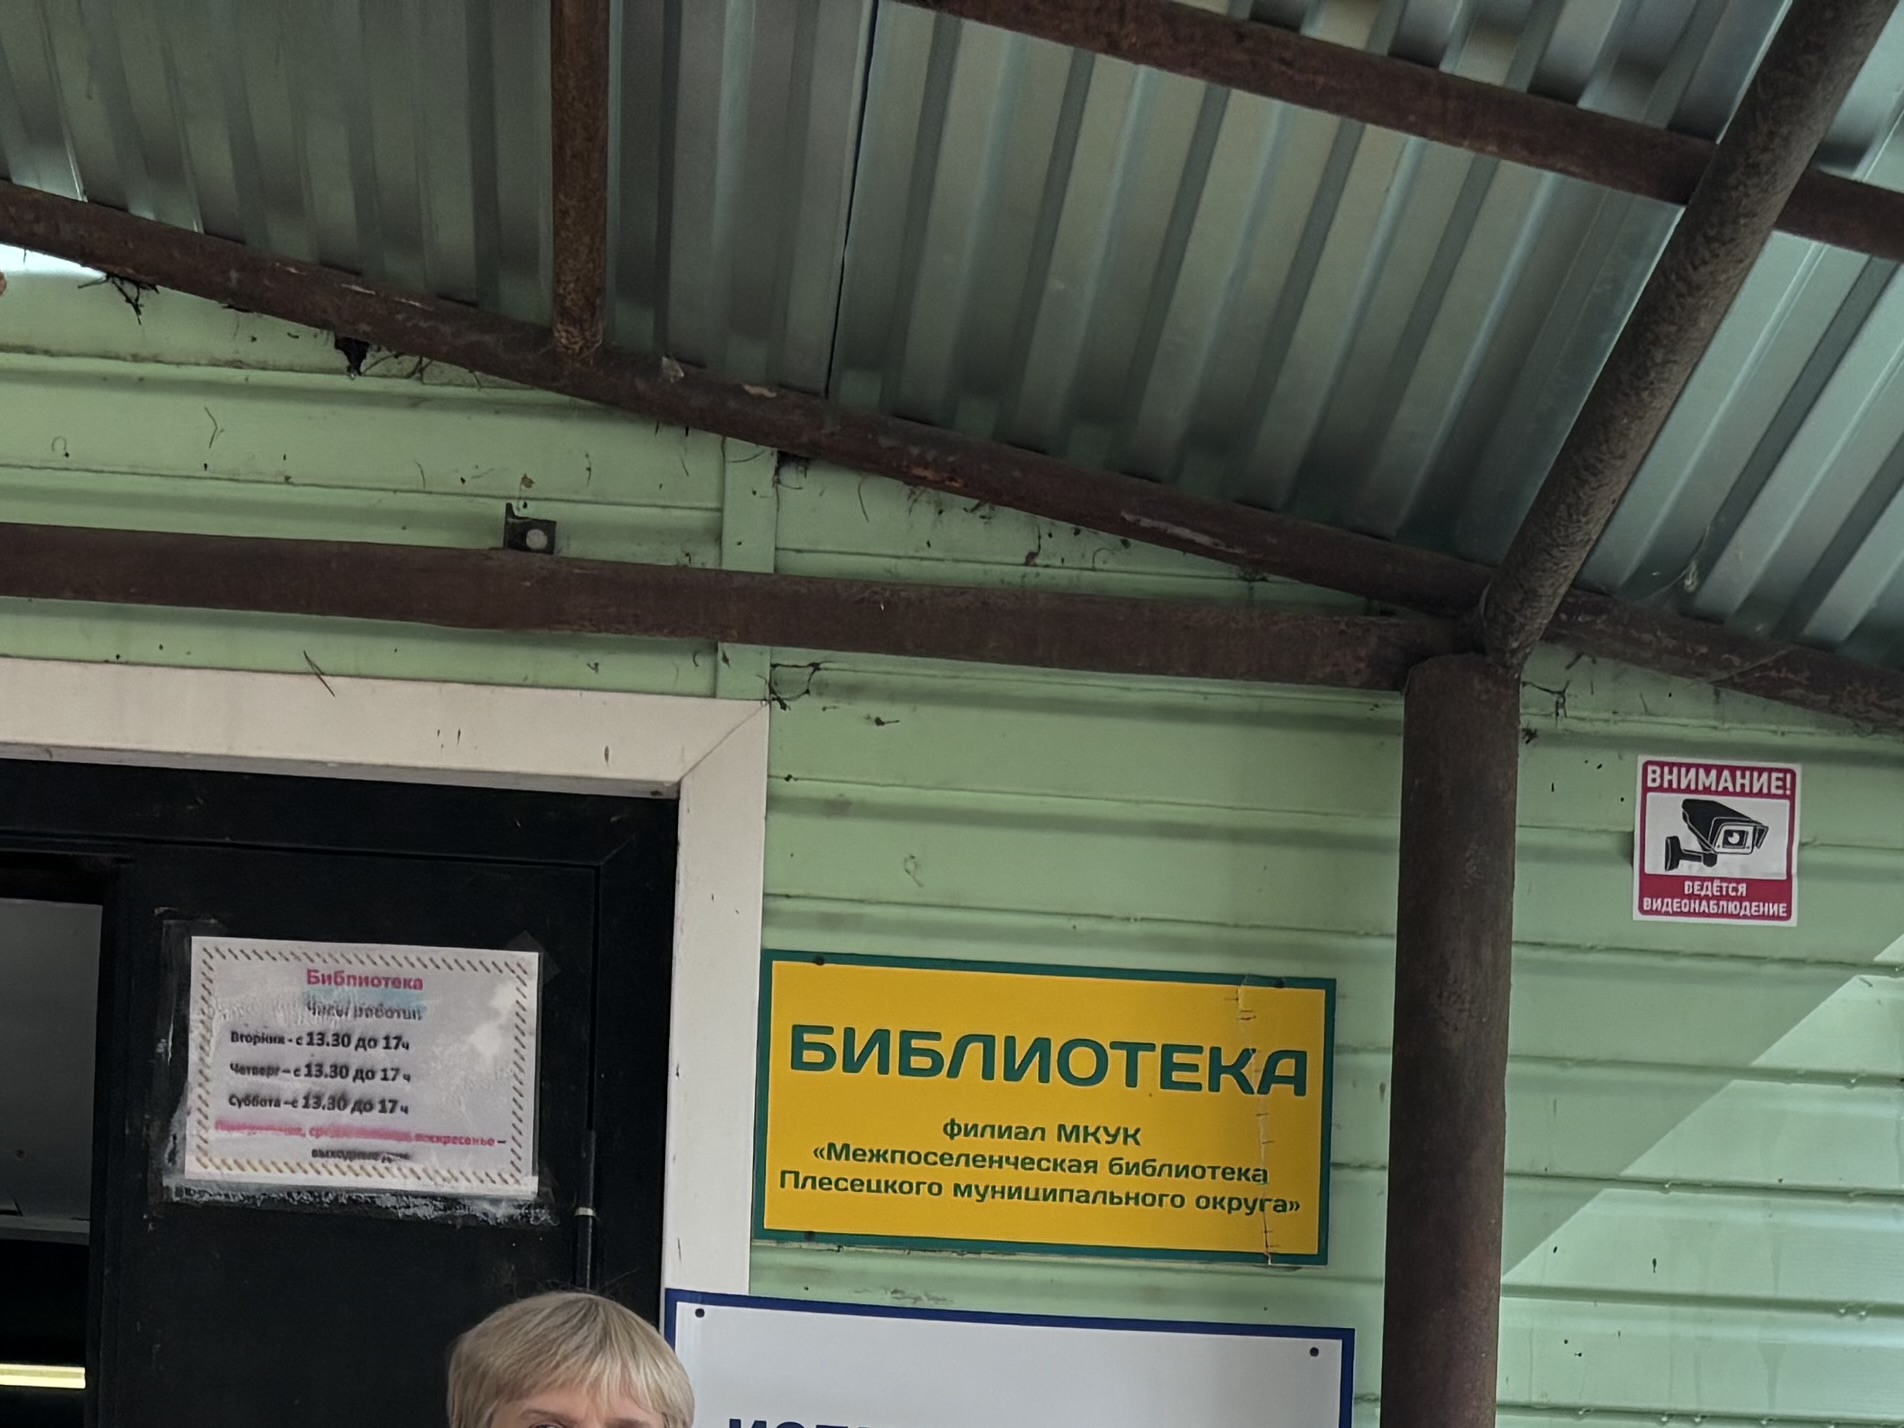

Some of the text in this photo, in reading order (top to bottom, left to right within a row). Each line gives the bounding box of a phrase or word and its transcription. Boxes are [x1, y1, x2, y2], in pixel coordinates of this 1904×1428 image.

[1647, 764, 1792, 795] ВНИМАНИЕ!
[1684, 879, 1747, 897] ВЕДЁТСЯ
[1642, 897, 1788, 918] ВИДЕОНАБЛЮДЕНИЕ
[306, 968, 424, 991] Библиотека
[306, 1030, 352, 1048] 13.30
[354, 1036, 378, 1051] до
[229, 1062, 280, 1078] Четверг
[303, 1062, 350, 1080] 13.30
[352, 1067, 376, 1083] до
[380, 1066, 401, 1082] 17
[789, 1023, 1309, 1099] БИБЛИОТЕКА
[228, 1093, 282, 1109] Суббота
[302, 1094, 347, 1112] 13.30
[350, 1098, 374, 1115] до
[378, 1098, 399, 1114] 17
[943, 1117, 1142, 1146] филиал МКУК
[813, 1142, 1270, 1185] «Межпоселенческая библиотека
[780, 1170, 1301, 1217] Плесецкого муниципального округа»
